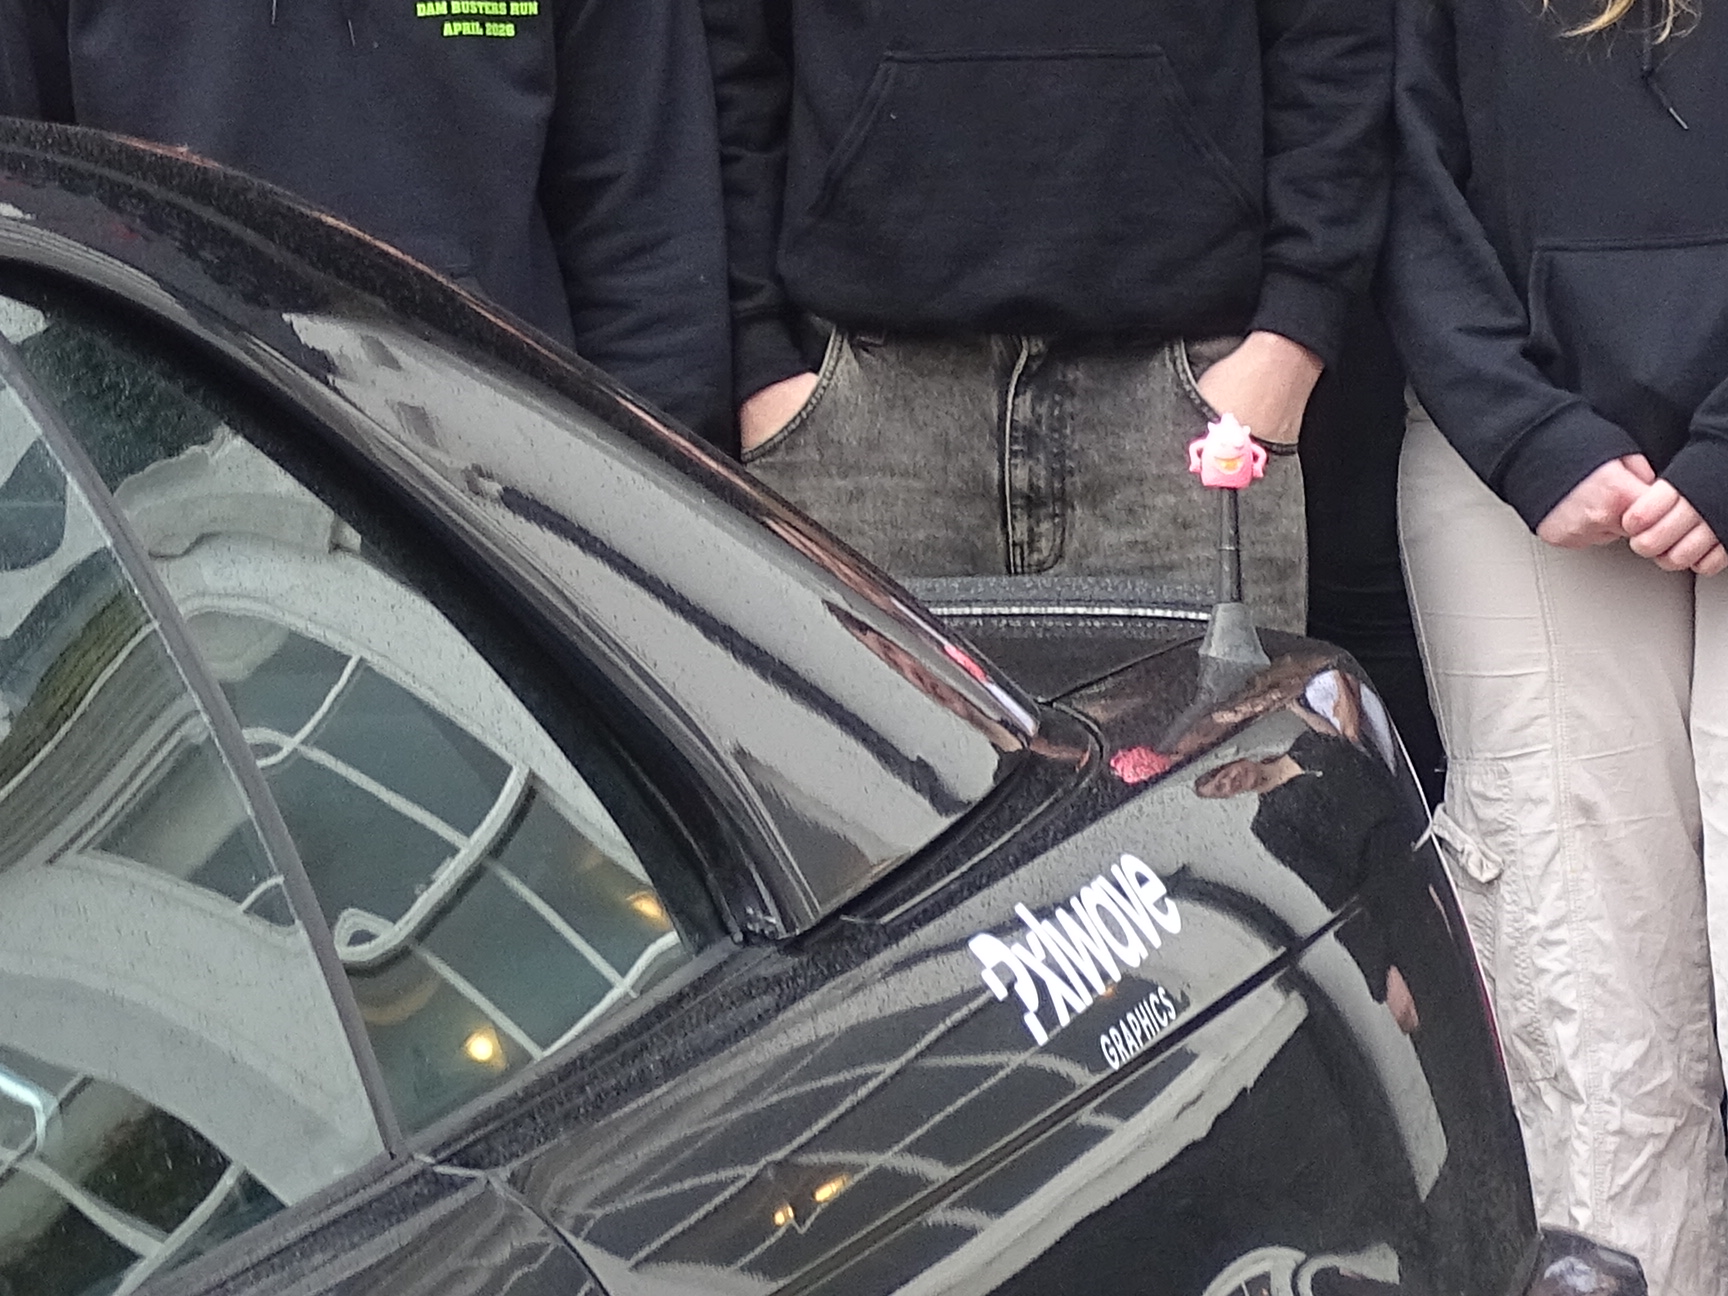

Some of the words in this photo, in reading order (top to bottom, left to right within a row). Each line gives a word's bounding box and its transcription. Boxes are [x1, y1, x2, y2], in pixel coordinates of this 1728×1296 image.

[416, 0, 448, 17] DAM
[450, 0, 508, 16] BUSTERS
[510, 0, 539, 17] RUN
[442, 20, 484, 37] APRIL
[1099, 985, 1179, 1071] GRAPHICS
